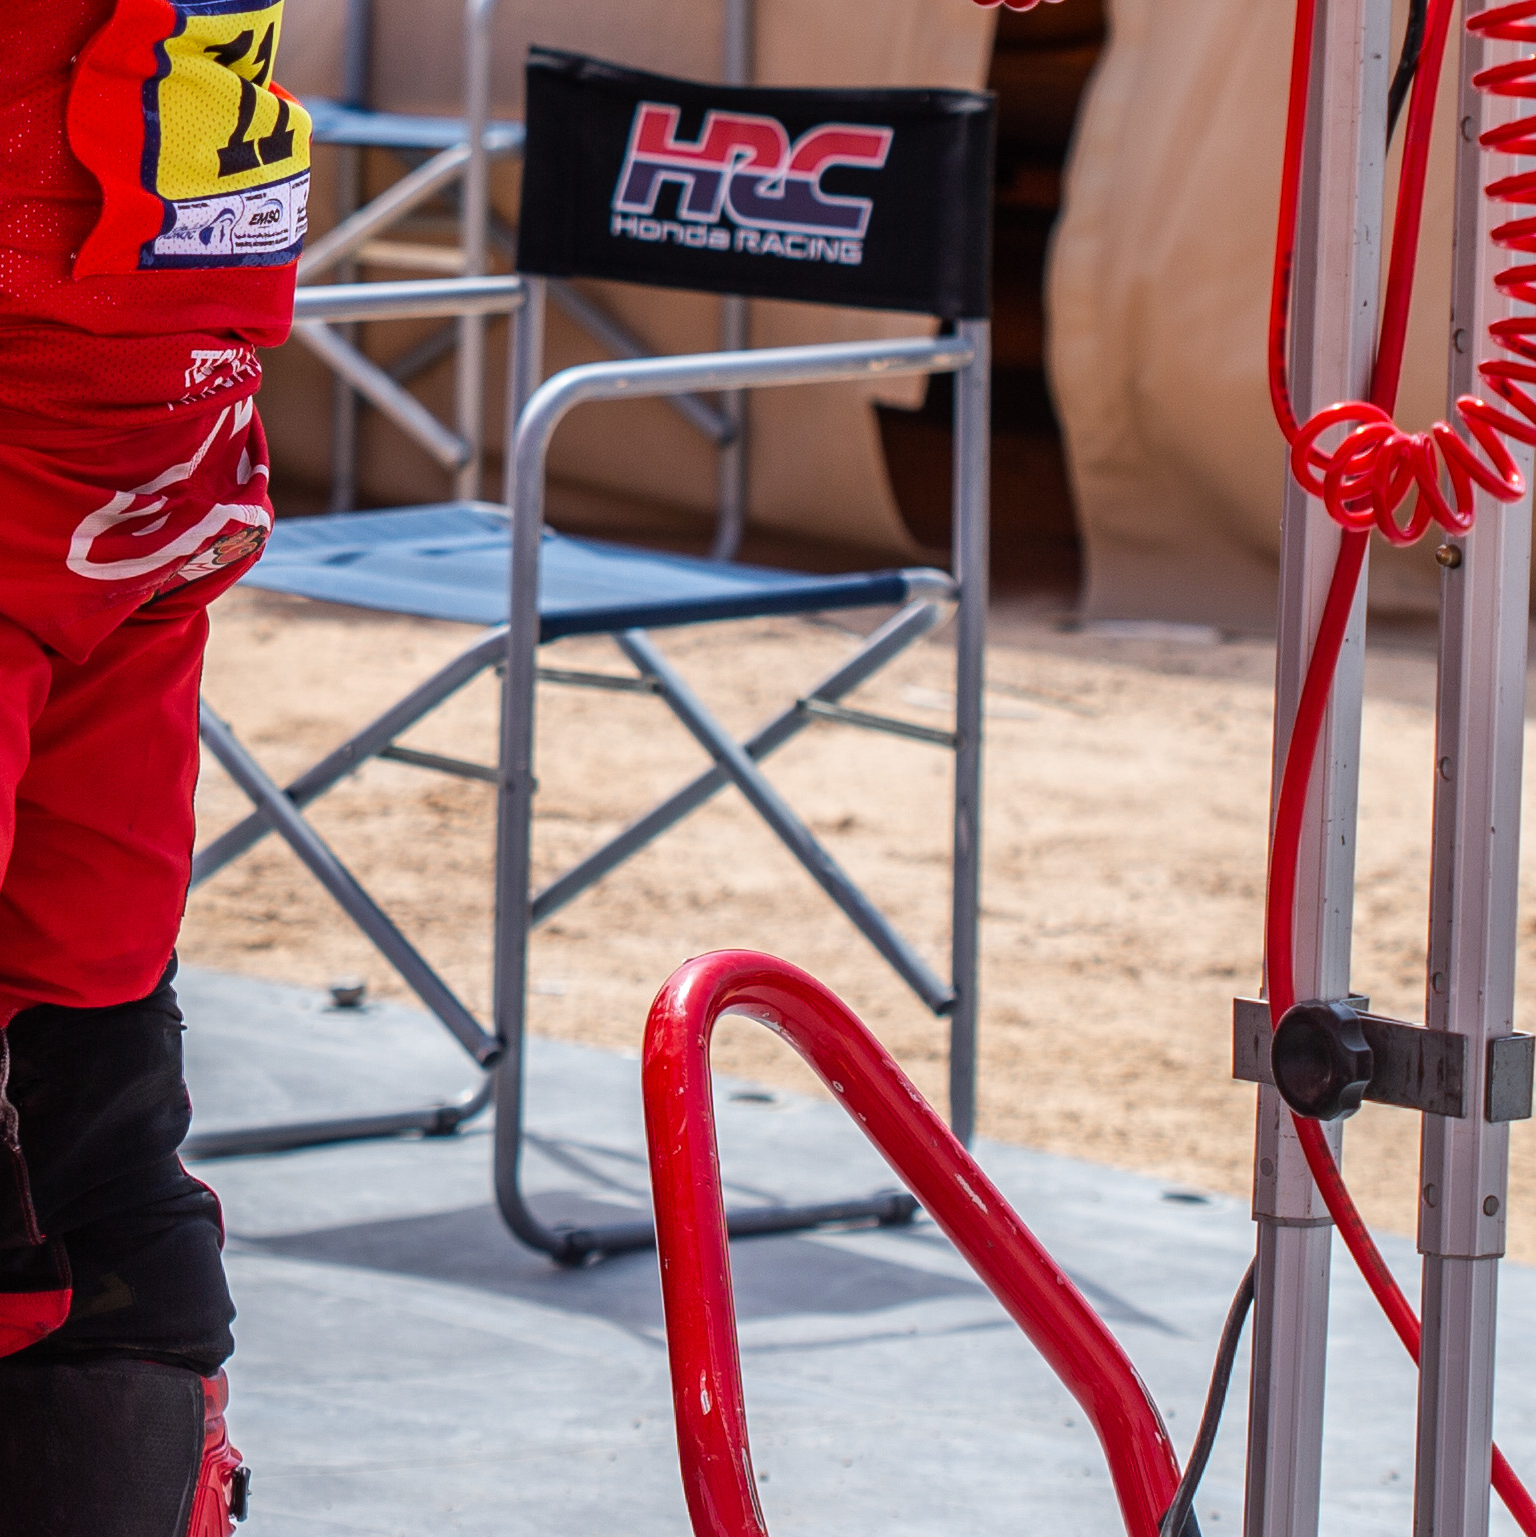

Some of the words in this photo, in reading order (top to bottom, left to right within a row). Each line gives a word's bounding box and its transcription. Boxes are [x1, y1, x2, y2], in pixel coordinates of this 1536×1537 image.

[611, 101, 895, 240] HRC
[611, 212, 733, 252] Honda
[734, 229, 864, 266] RACING
